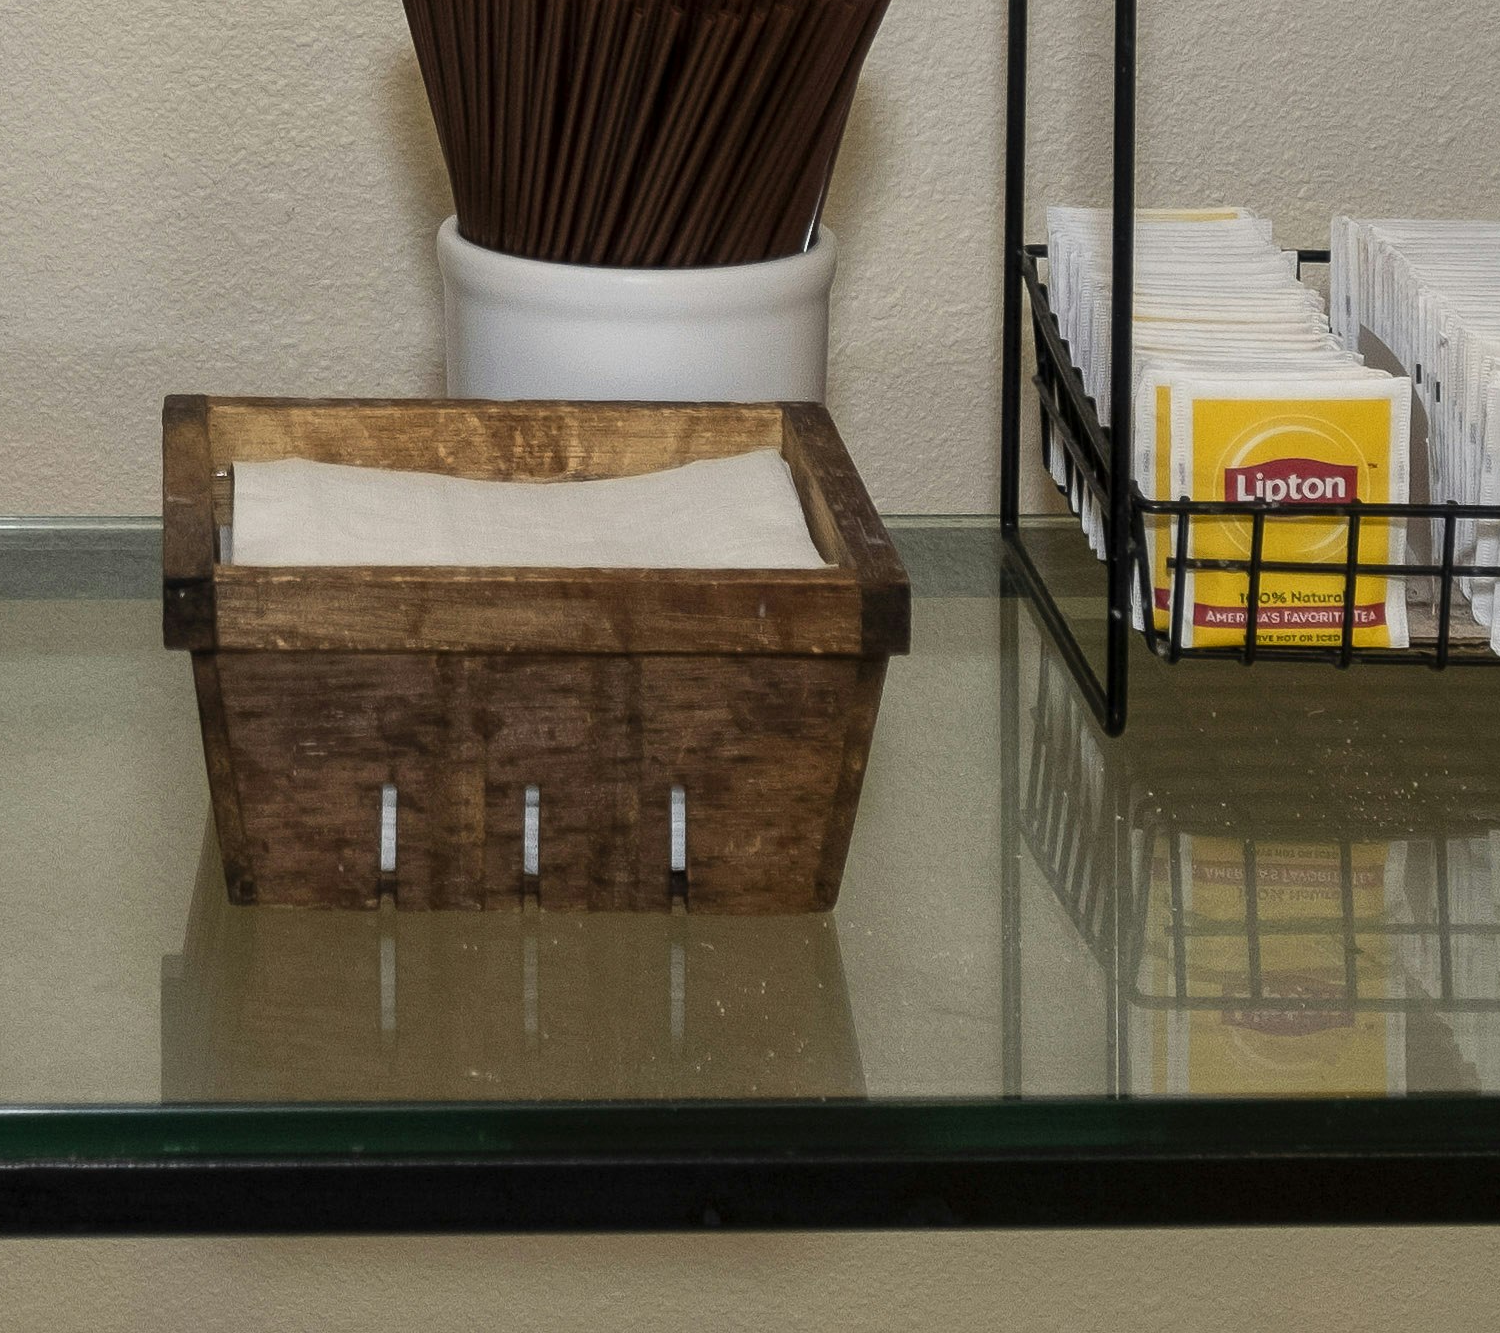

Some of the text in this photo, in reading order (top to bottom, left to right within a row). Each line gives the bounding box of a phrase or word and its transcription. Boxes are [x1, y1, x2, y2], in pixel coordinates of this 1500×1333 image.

[1236, 472, 1346, 506] Lipton
[1240, 591, 1286, 604] 10%
[1205, 609, 1376, 624] AMERIA'S FAVORIT TEA
[1243, 634, 1341, 643] RVE HOT OR ICED
